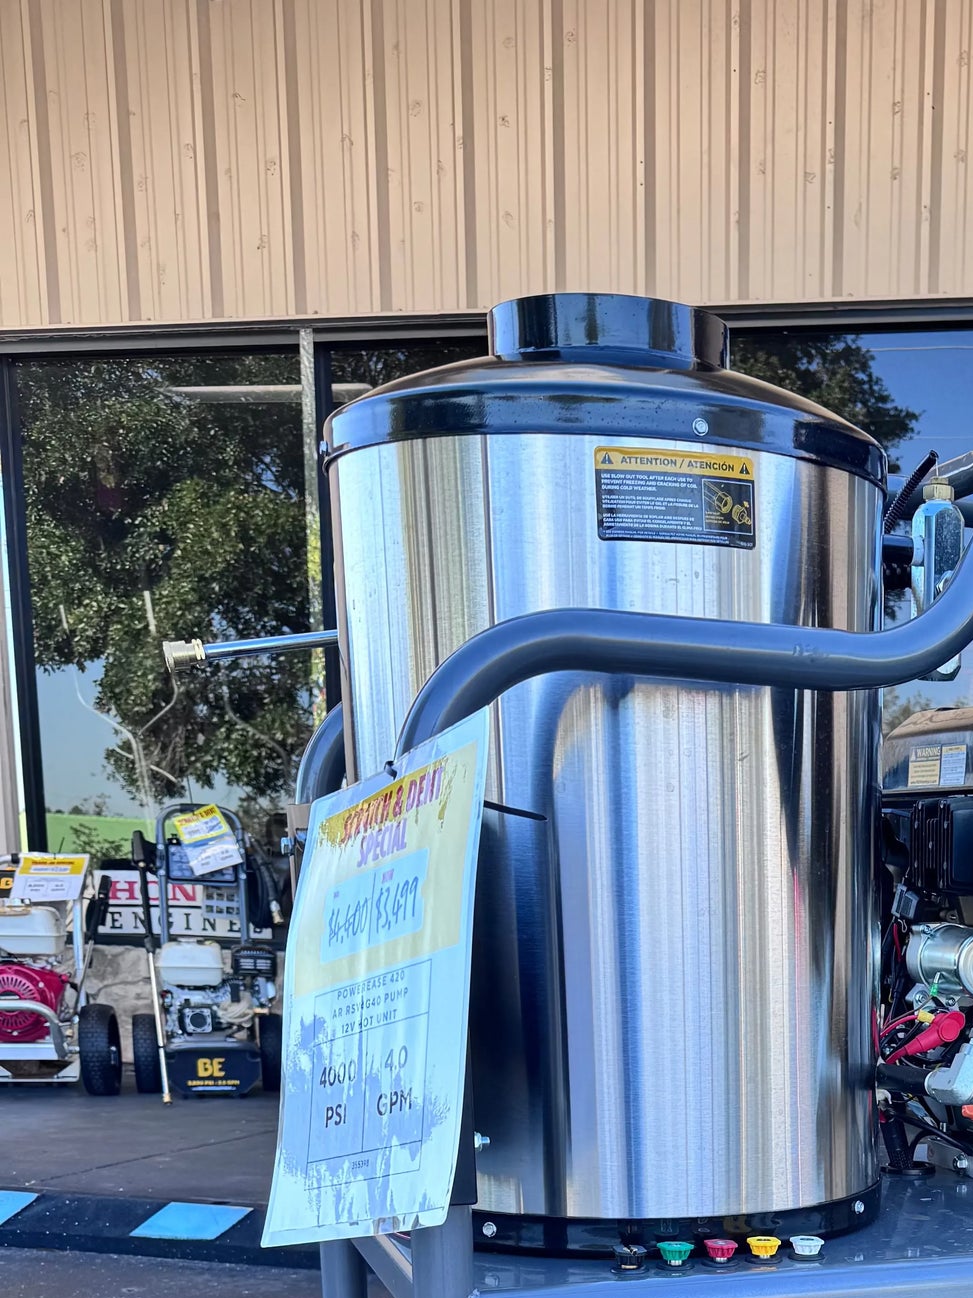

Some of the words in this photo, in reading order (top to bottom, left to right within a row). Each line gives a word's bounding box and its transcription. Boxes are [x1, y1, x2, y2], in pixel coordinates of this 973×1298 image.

[620, 455, 677, 467] ATTENTION
[687, 460, 735, 472] ATENCIÓN
[392, 785, 405, 817] &
[405, 766, 444, 811] DENT
[357, 817, 408, 868] SPECIAL
[109, 880, 197, 902] HON
[375, 876, 419, 933] $3,499
[337, 976, 387, 1000] POWEREASE
[390, 970, 405, 983] 420
[384, 987, 409, 1003] PUMP
[341, 1021, 355, 1034] 12V
[376, 1009, 397, 1024] UNIT
[197, 1057, 225, 1078] BE
[319, 1060, 357, 1089] 4000
[384, 1045, 408, 1072] 4.0
[325, 1103, 347, 1128] PSI
[377, 1086, 413, 1117] GPM
